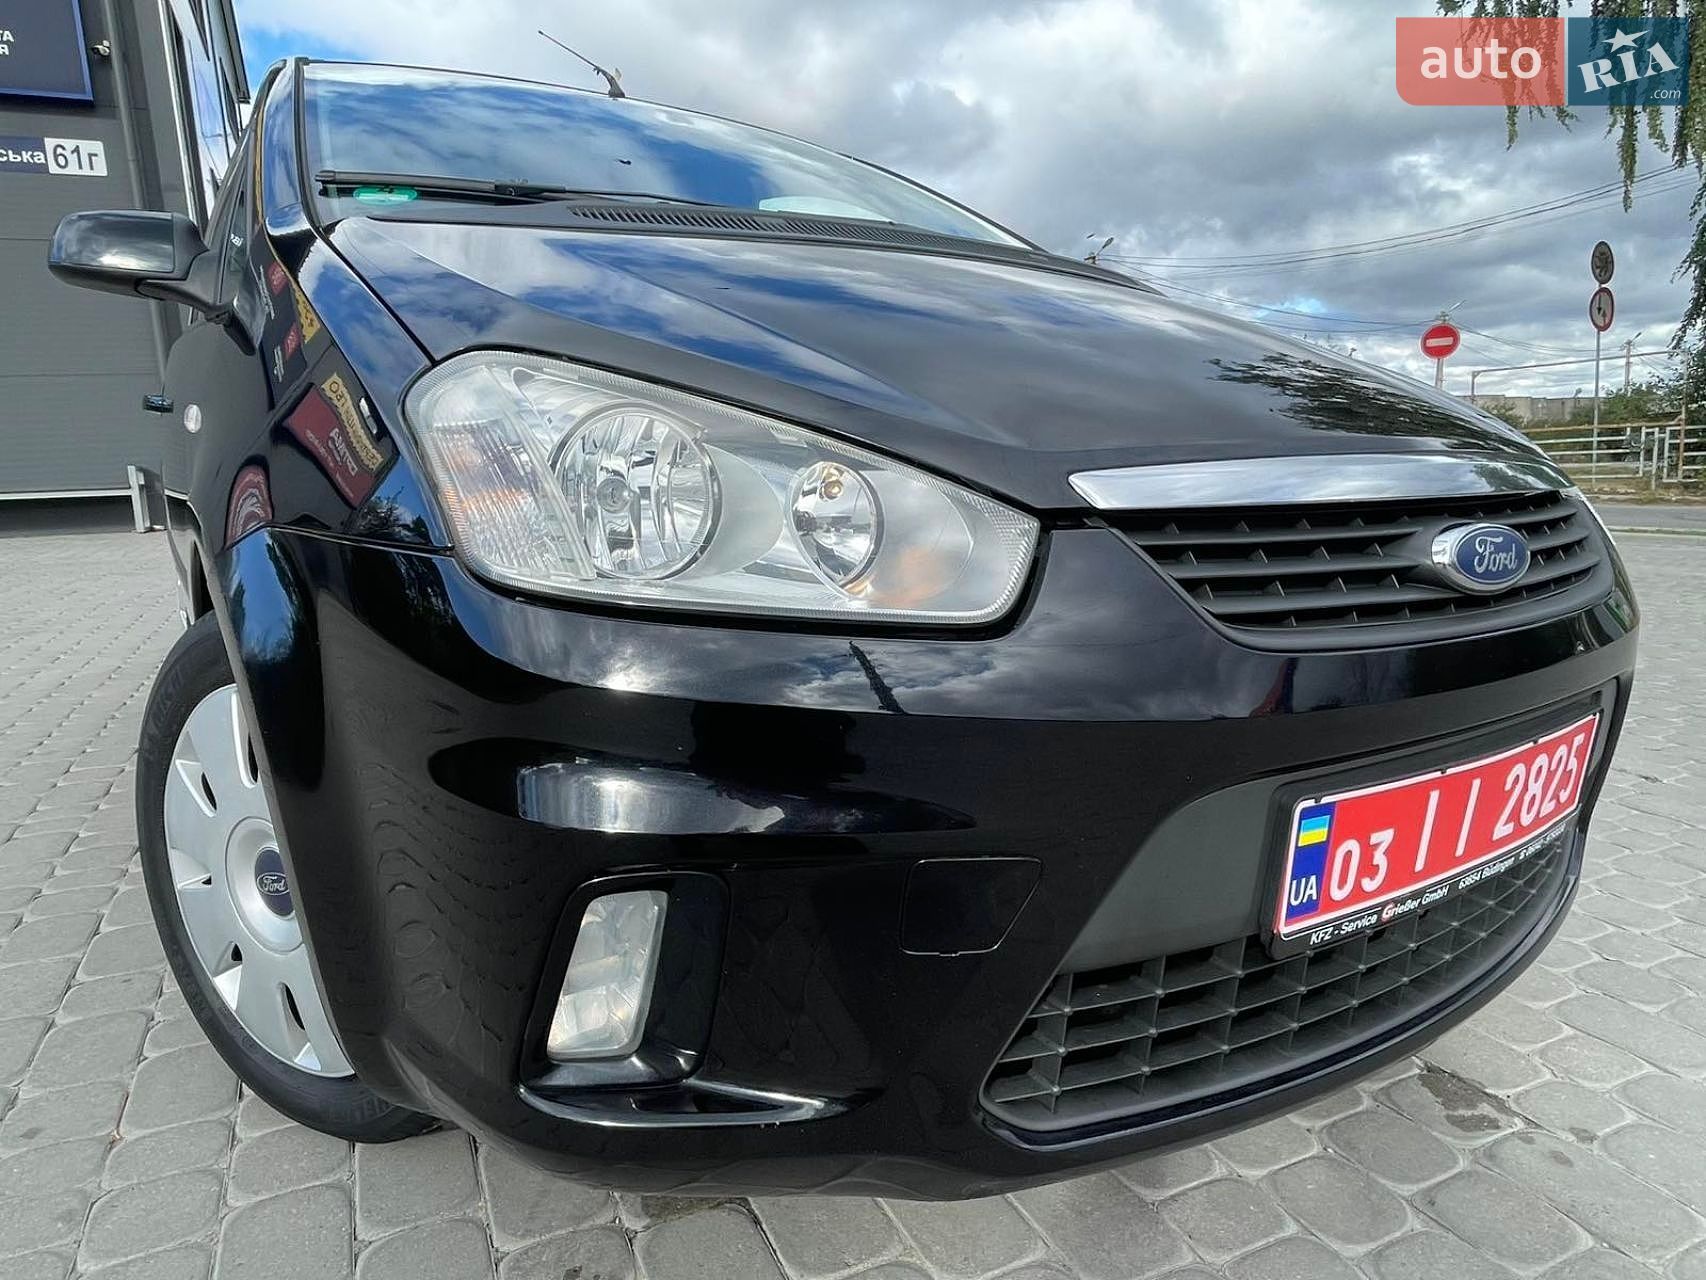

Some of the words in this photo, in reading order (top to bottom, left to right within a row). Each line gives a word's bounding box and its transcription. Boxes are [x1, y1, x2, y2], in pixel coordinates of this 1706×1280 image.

[1474, 536, 1518, 573] Ford
[1492, 732, 1585, 842] 2825
[262, 875, 287, 892] Ford
[1289, 874, 1318, 906] UA
[1309, 926, 1334, 945] KFZ
[1340, 914, 1378, 935] Service
[1422, 884, 1450, 906] GmbH
